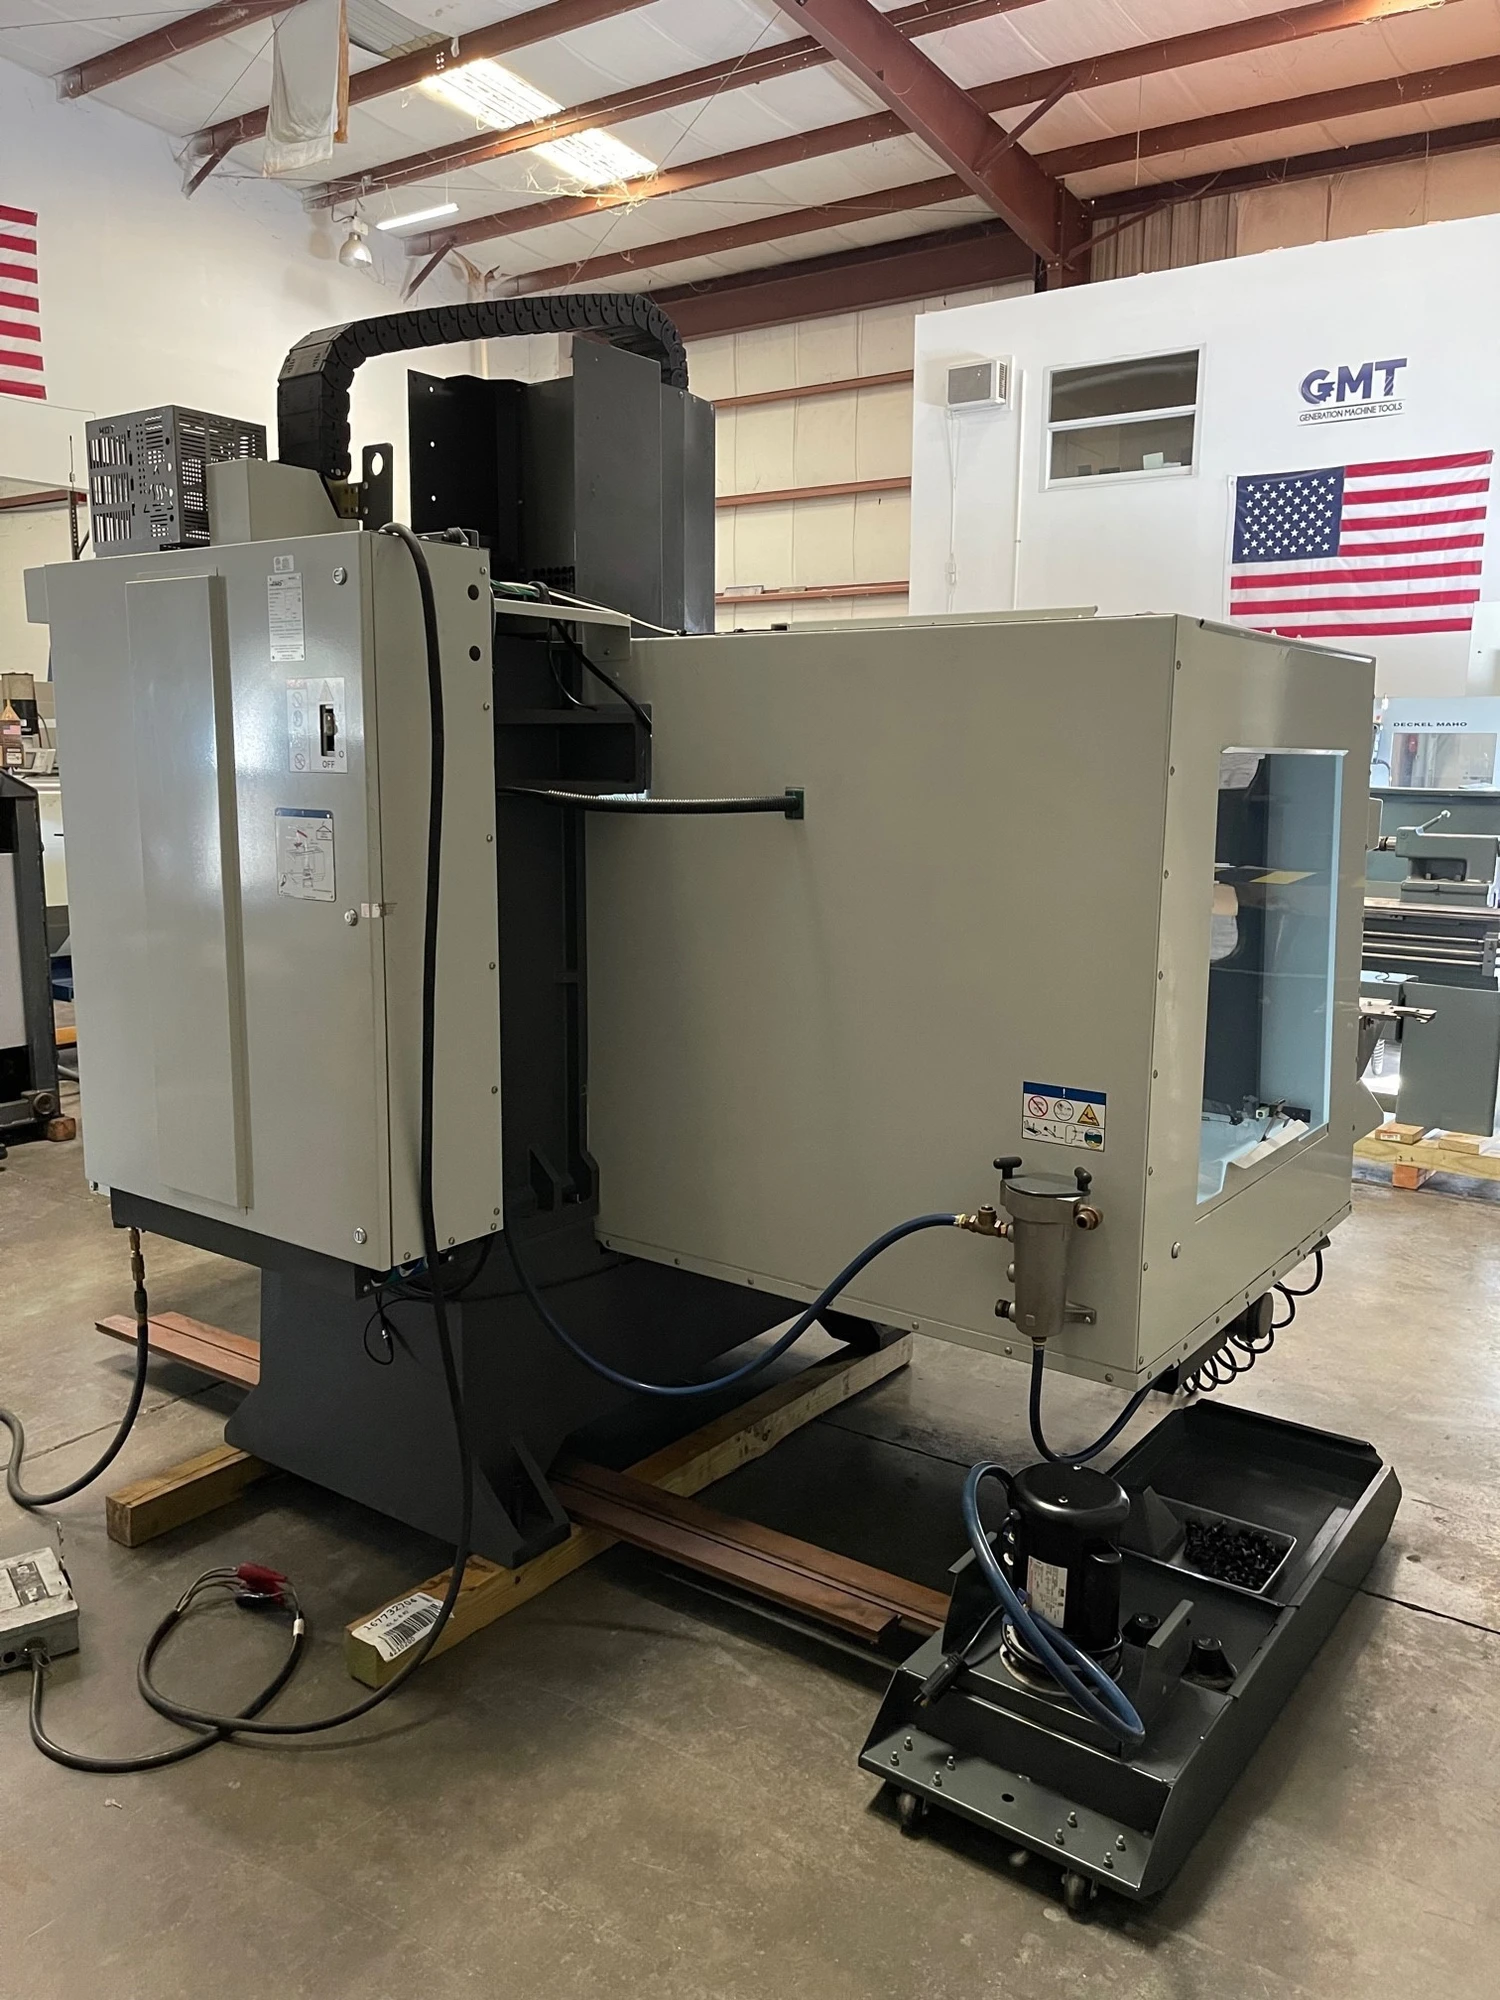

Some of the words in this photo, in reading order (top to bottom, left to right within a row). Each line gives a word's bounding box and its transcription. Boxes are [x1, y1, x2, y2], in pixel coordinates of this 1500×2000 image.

[1301, 358, 1407, 404] GMT
[1299, 410, 1344, 422] GENERATION
[1344, 405, 1377, 417] MACHINE
[1378, 402, 1403, 413] TOOLS
[322, 760, 335, 769] OFF
